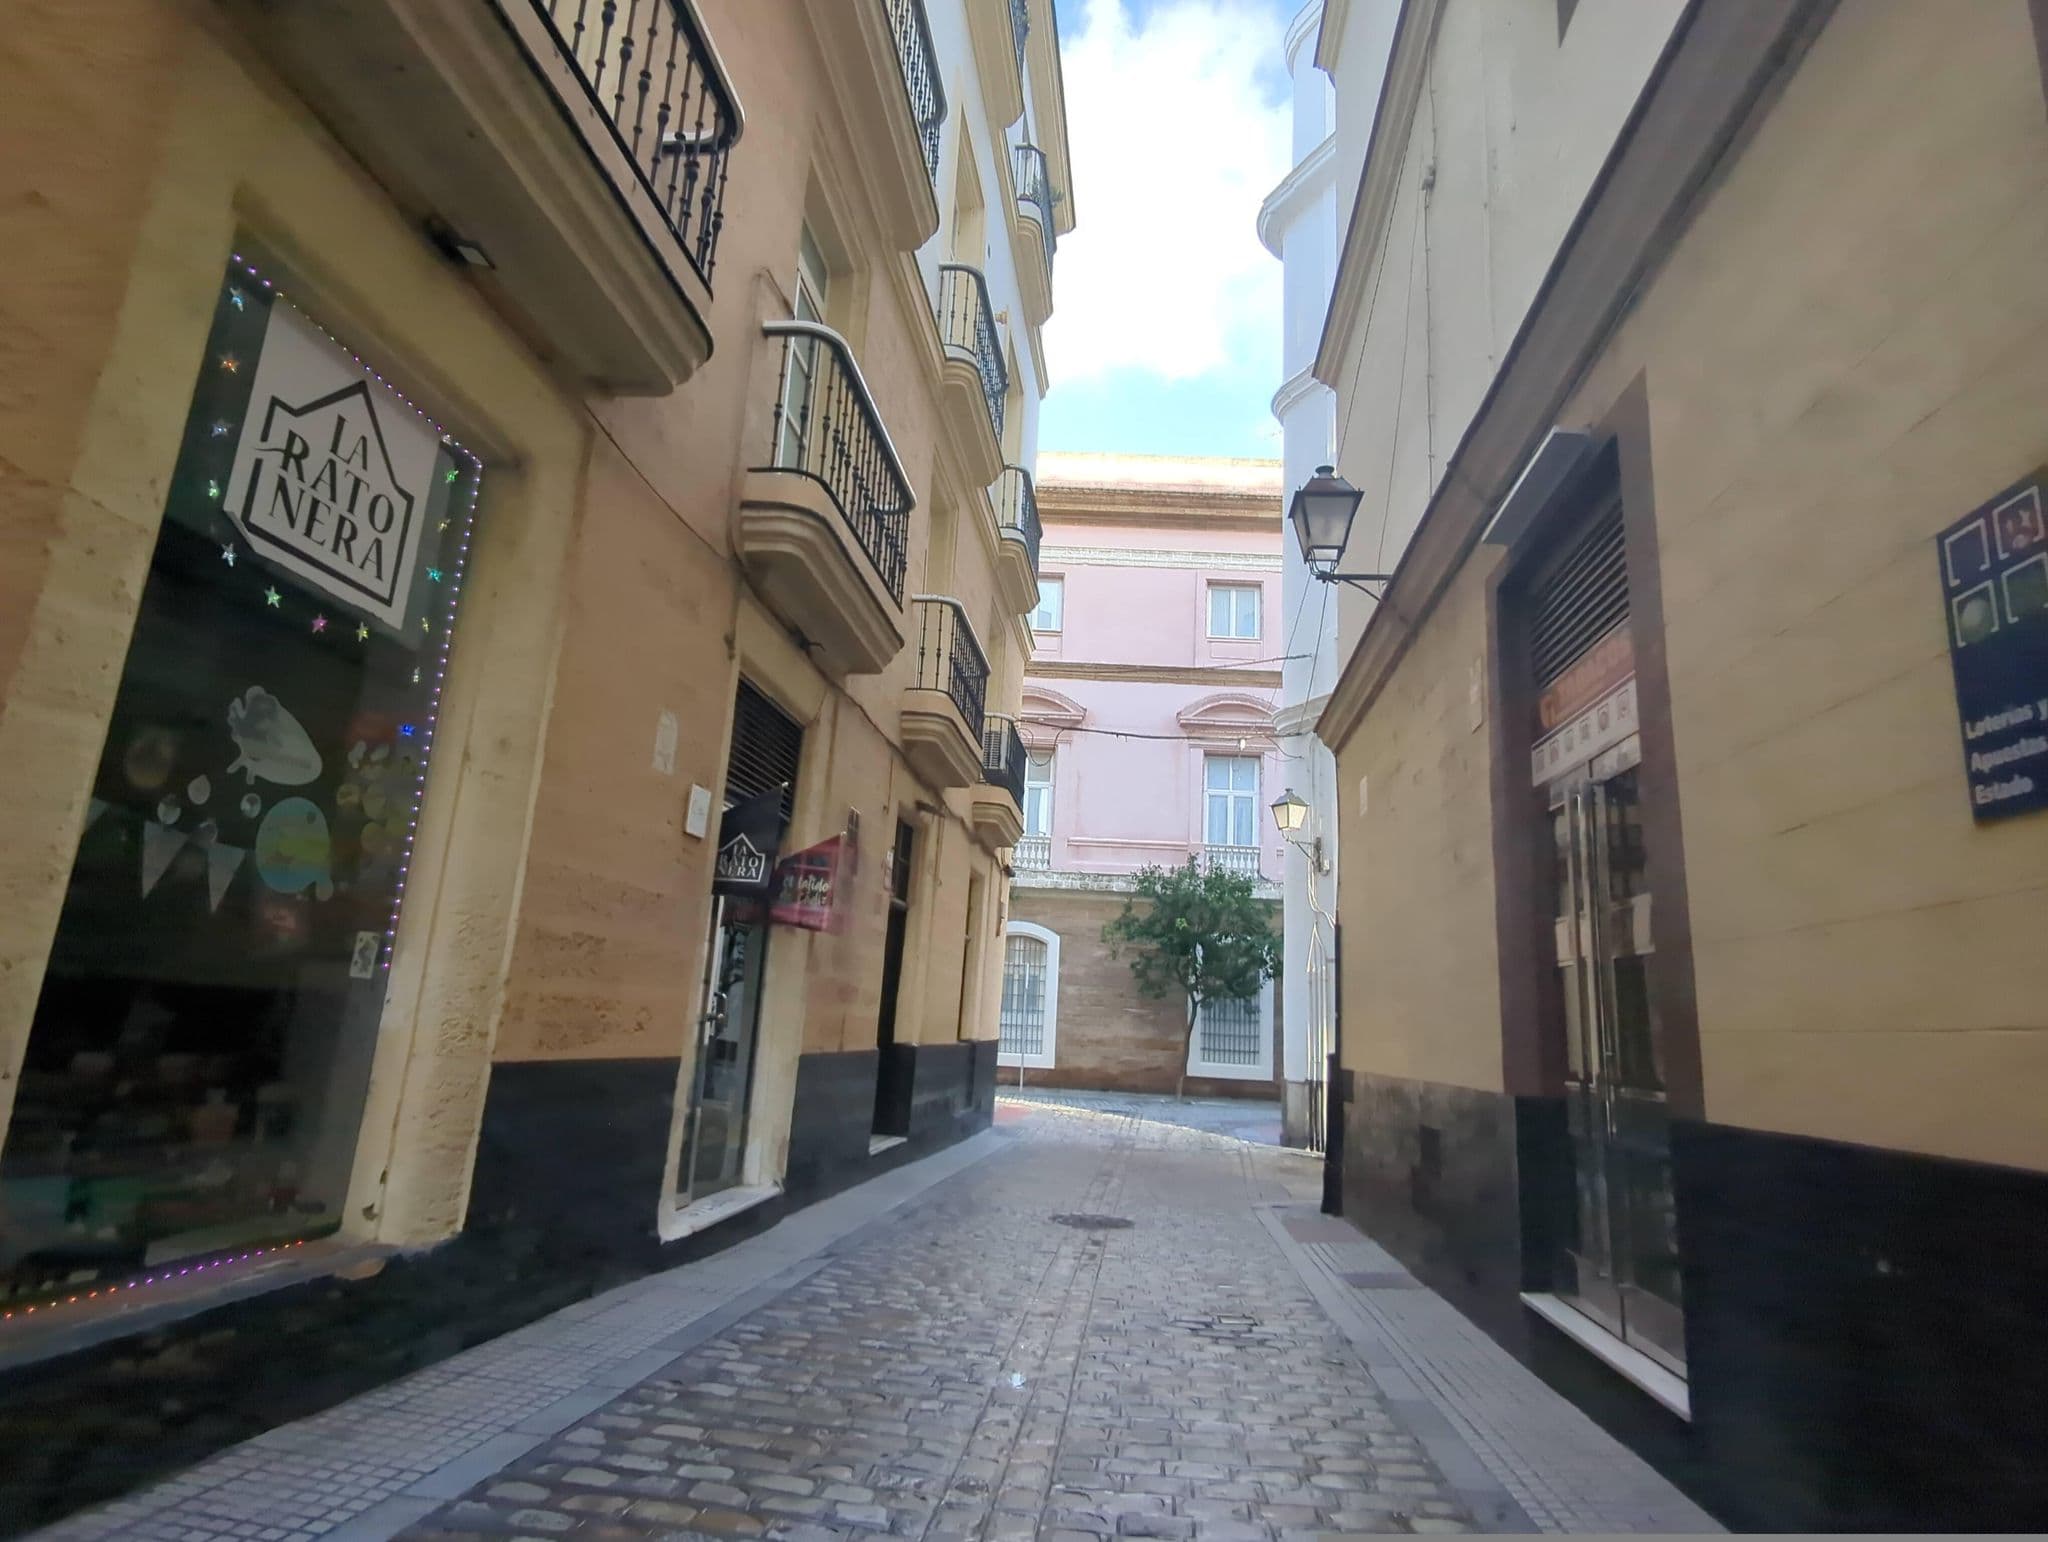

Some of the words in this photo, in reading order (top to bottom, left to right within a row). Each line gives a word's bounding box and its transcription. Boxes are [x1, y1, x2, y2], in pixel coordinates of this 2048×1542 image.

[278, 429, 395, 534] RATO
[330, 413, 368, 472] LA
[269, 473, 384, 582] NERA
[733, 843, 748, 856] LA
